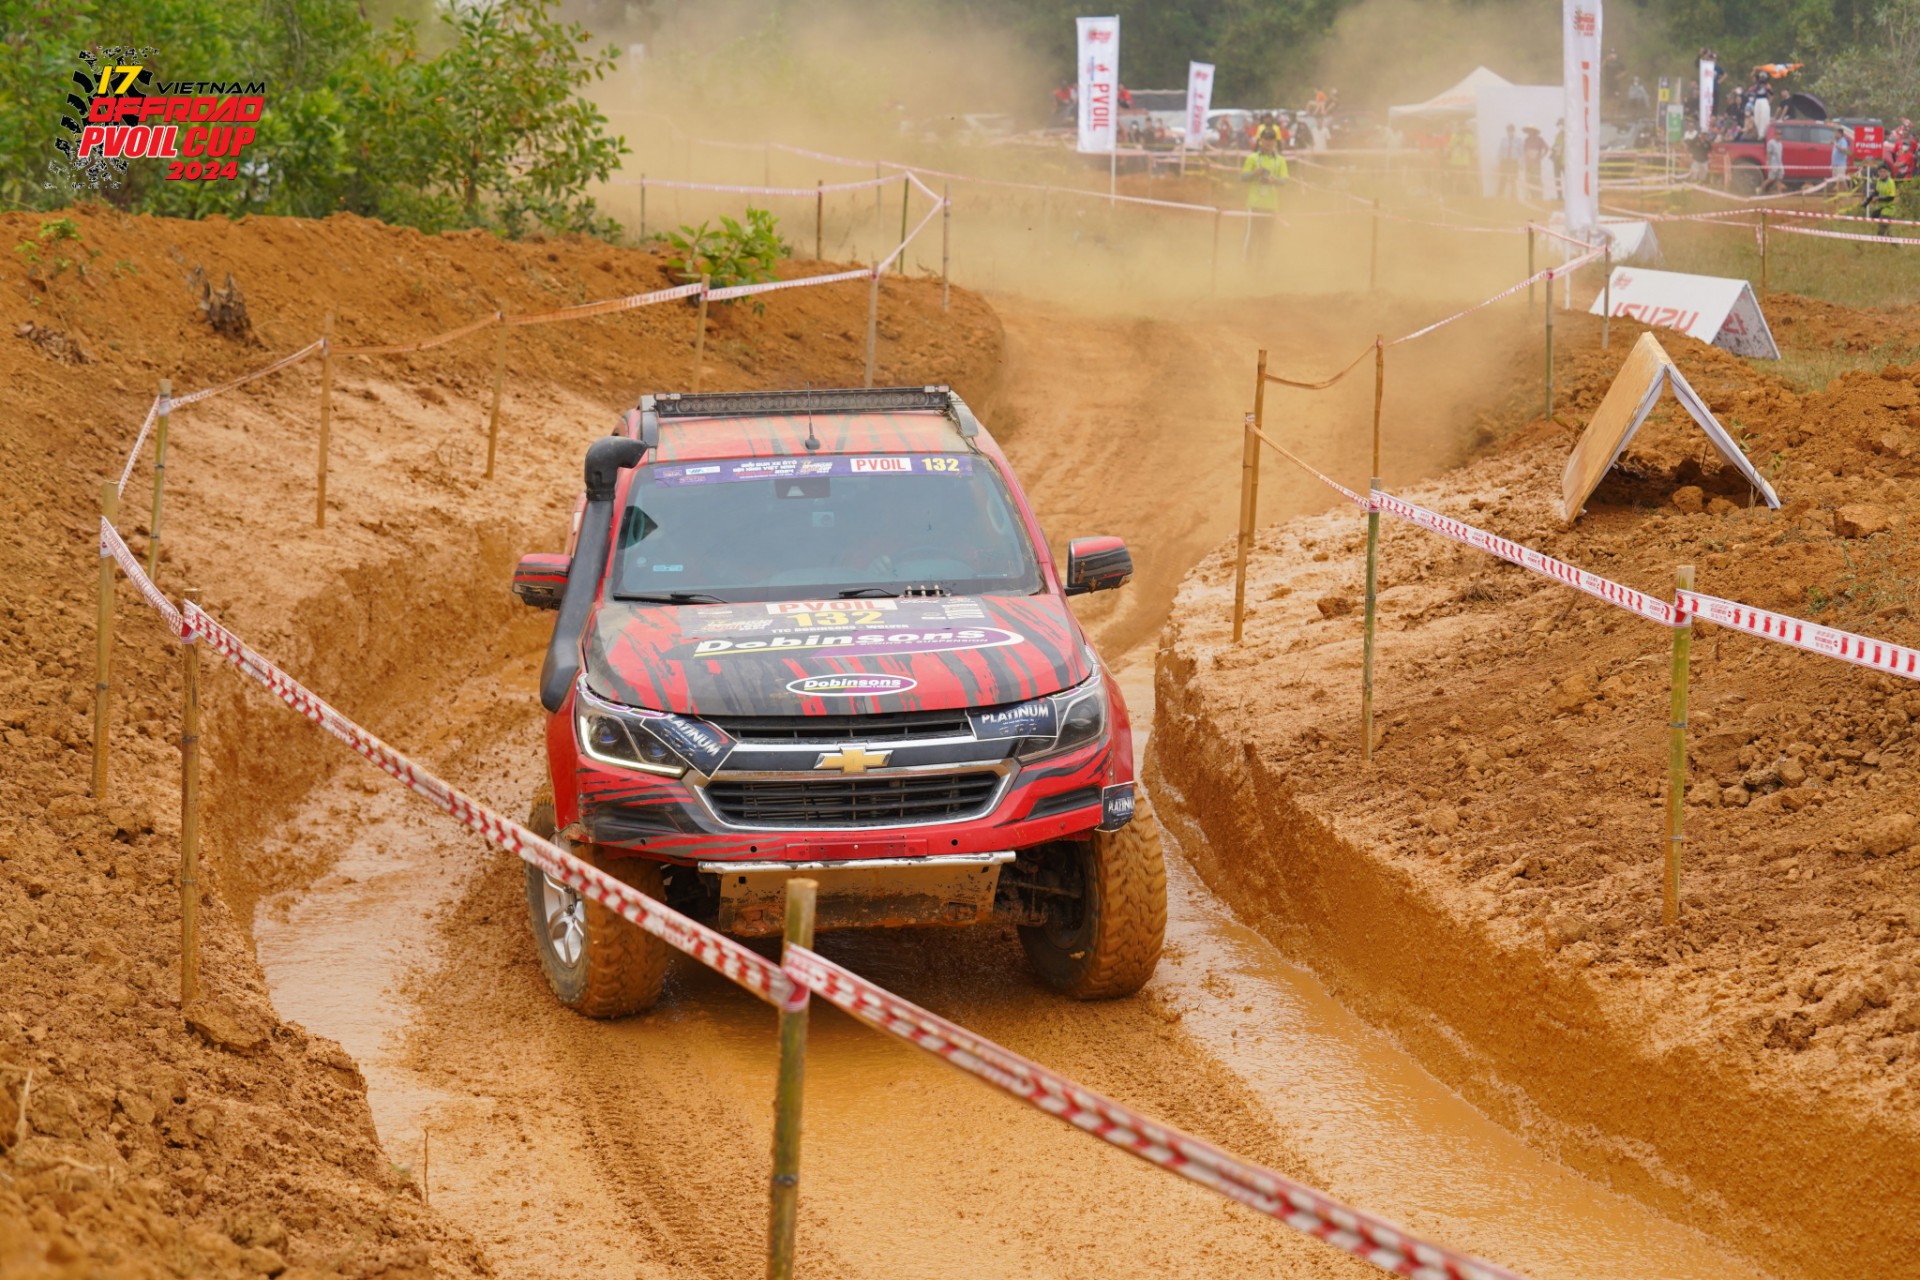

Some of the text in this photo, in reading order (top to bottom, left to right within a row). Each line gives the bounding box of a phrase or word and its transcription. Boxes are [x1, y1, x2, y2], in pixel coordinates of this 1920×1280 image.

[1092, 83, 1110, 131] PVOIL
[1613, 302, 1699, 333] ISUZU
[856, 459, 906, 471] PVOIL
[922, 458, 960, 472] 132
[779, 600, 886, 613] PVOIL
[786, 611, 885, 627] 132
[794, 625, 857, 633] DOBINSONS
[695, 629, 986, 654] Dobinsons
[804, 678, 901, 689] Dobinsons
[981, 704, 1049, 724] PLATINUM
[667, 713, 722, 757] LATINUM
[1108, 796, 1134, 813] PLATINU
